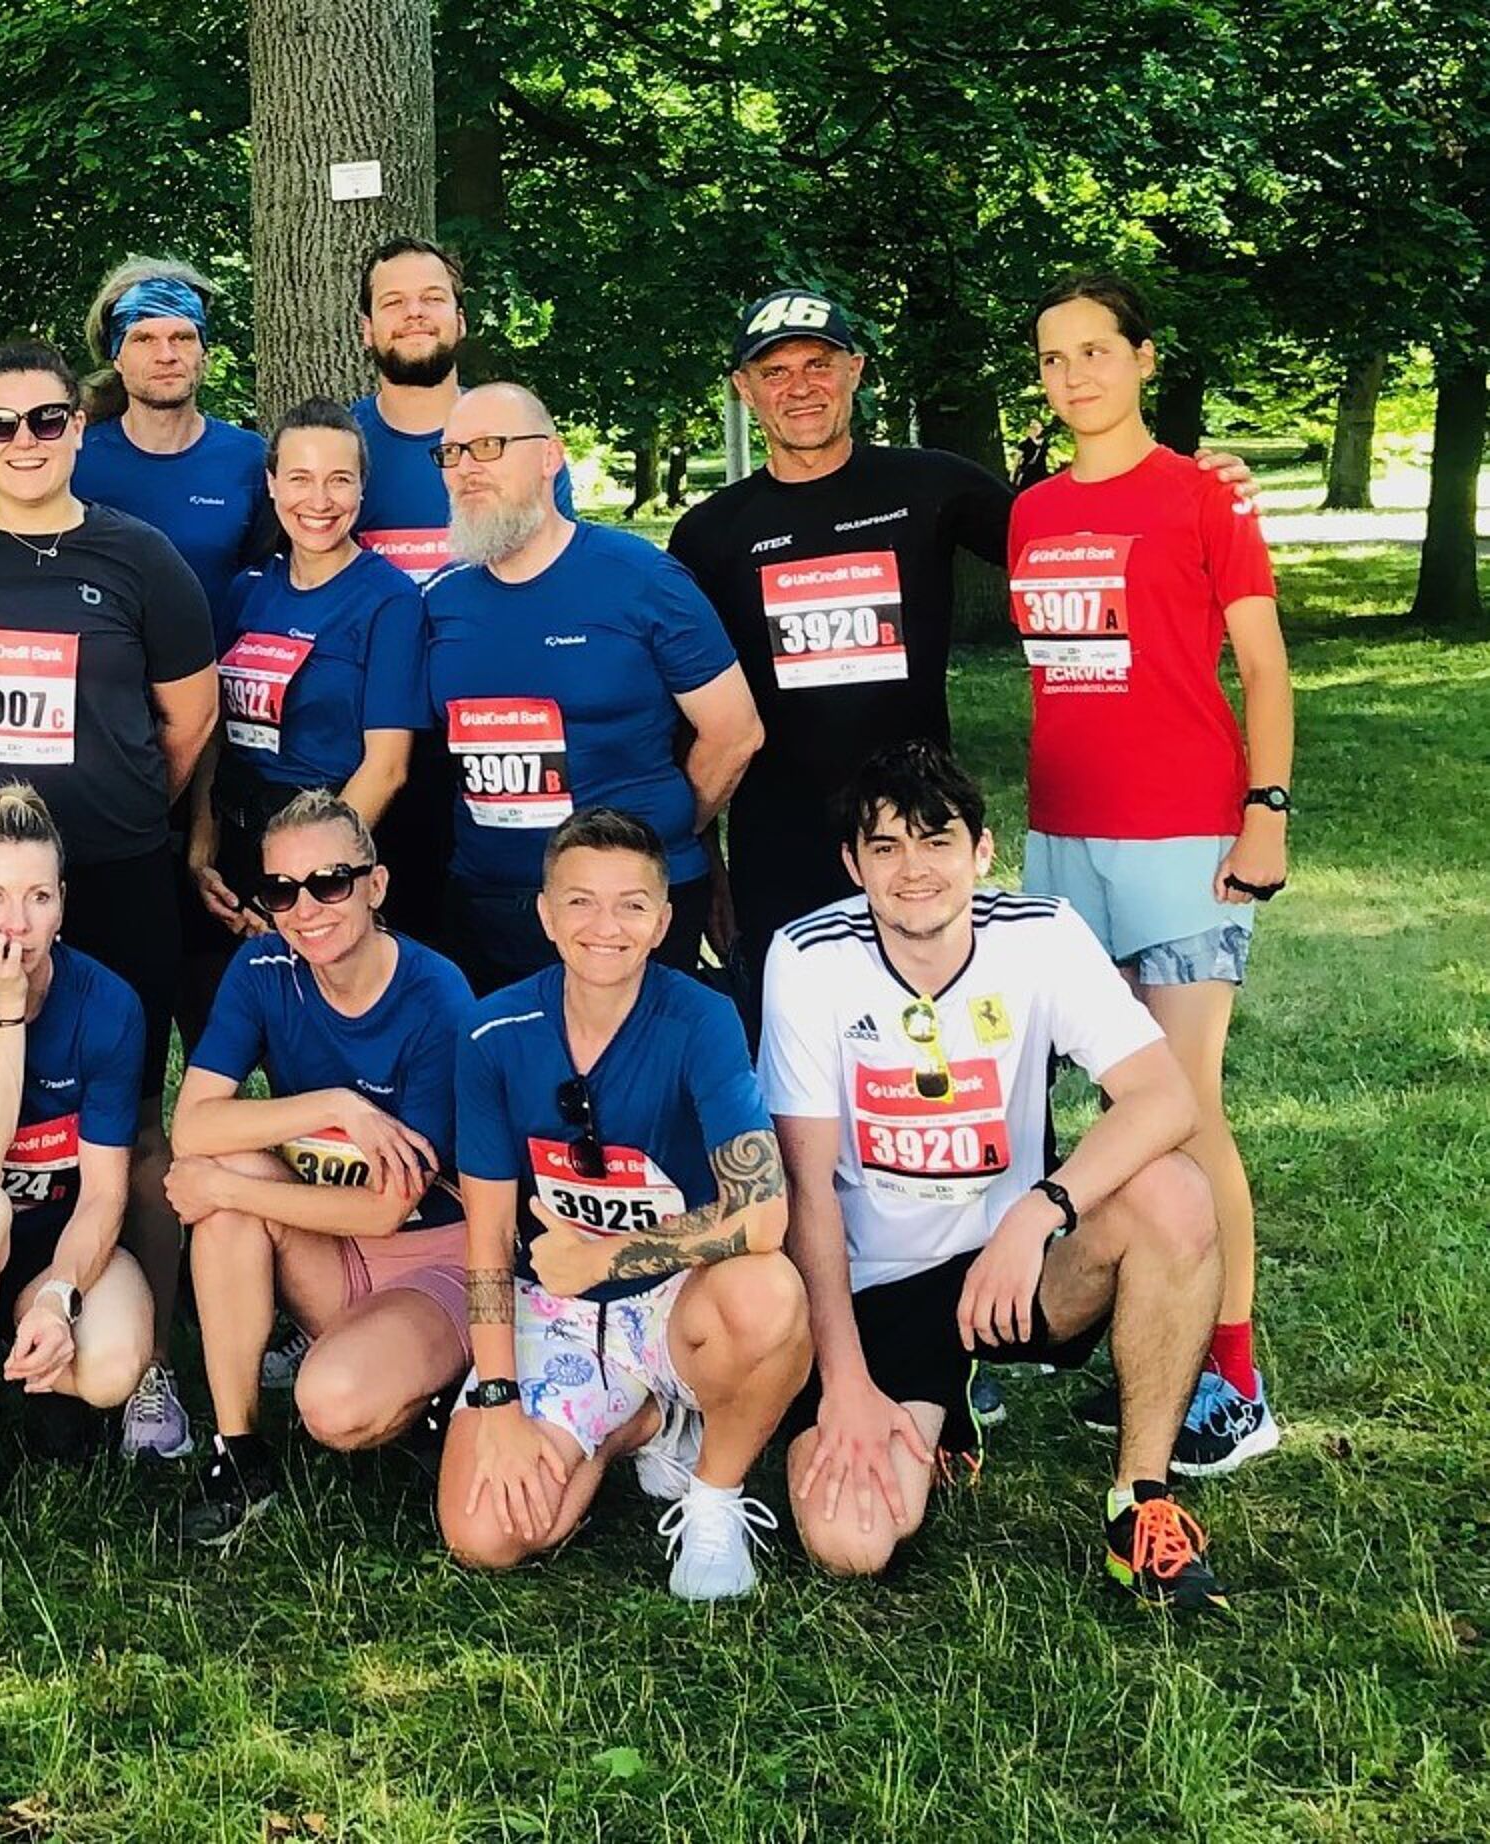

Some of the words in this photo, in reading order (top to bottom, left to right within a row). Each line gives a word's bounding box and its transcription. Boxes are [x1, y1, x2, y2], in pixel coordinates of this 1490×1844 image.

[746, 297, 831, 335] 46
[750, 534, 792, 553] ATEX
[1086, 546, 1116, 561] Bank
[792, 567, 849, 586] UniCredit
[850, 563, 883, 580] Bank
[1023, 590, 1101, 632] 3907
[1105, 608, 1118, 630] A
[779, 607, 878, 655] 3920
[879, 622, 895, 645] B
[31, 645, 63, 662] Bank
[223, 677, 270, 720] 3922
[51, 708, 64, 729] C
[471, 711, 519, 726] UniCredit
[520, 711, 549, 725] Bank
[462, 754, 541, 793] 3907
[545, 768, 561, 792] B
[41, 1130, 68, 1149] Bank
[869, 1125, 981, 1171] 3920
[984, 1144, 999, 1166] A
[297, 1151, 370, 1187] 390
[5, 1171, 52, 1201] 24
[552, 1189, 658, 1232] 3925
